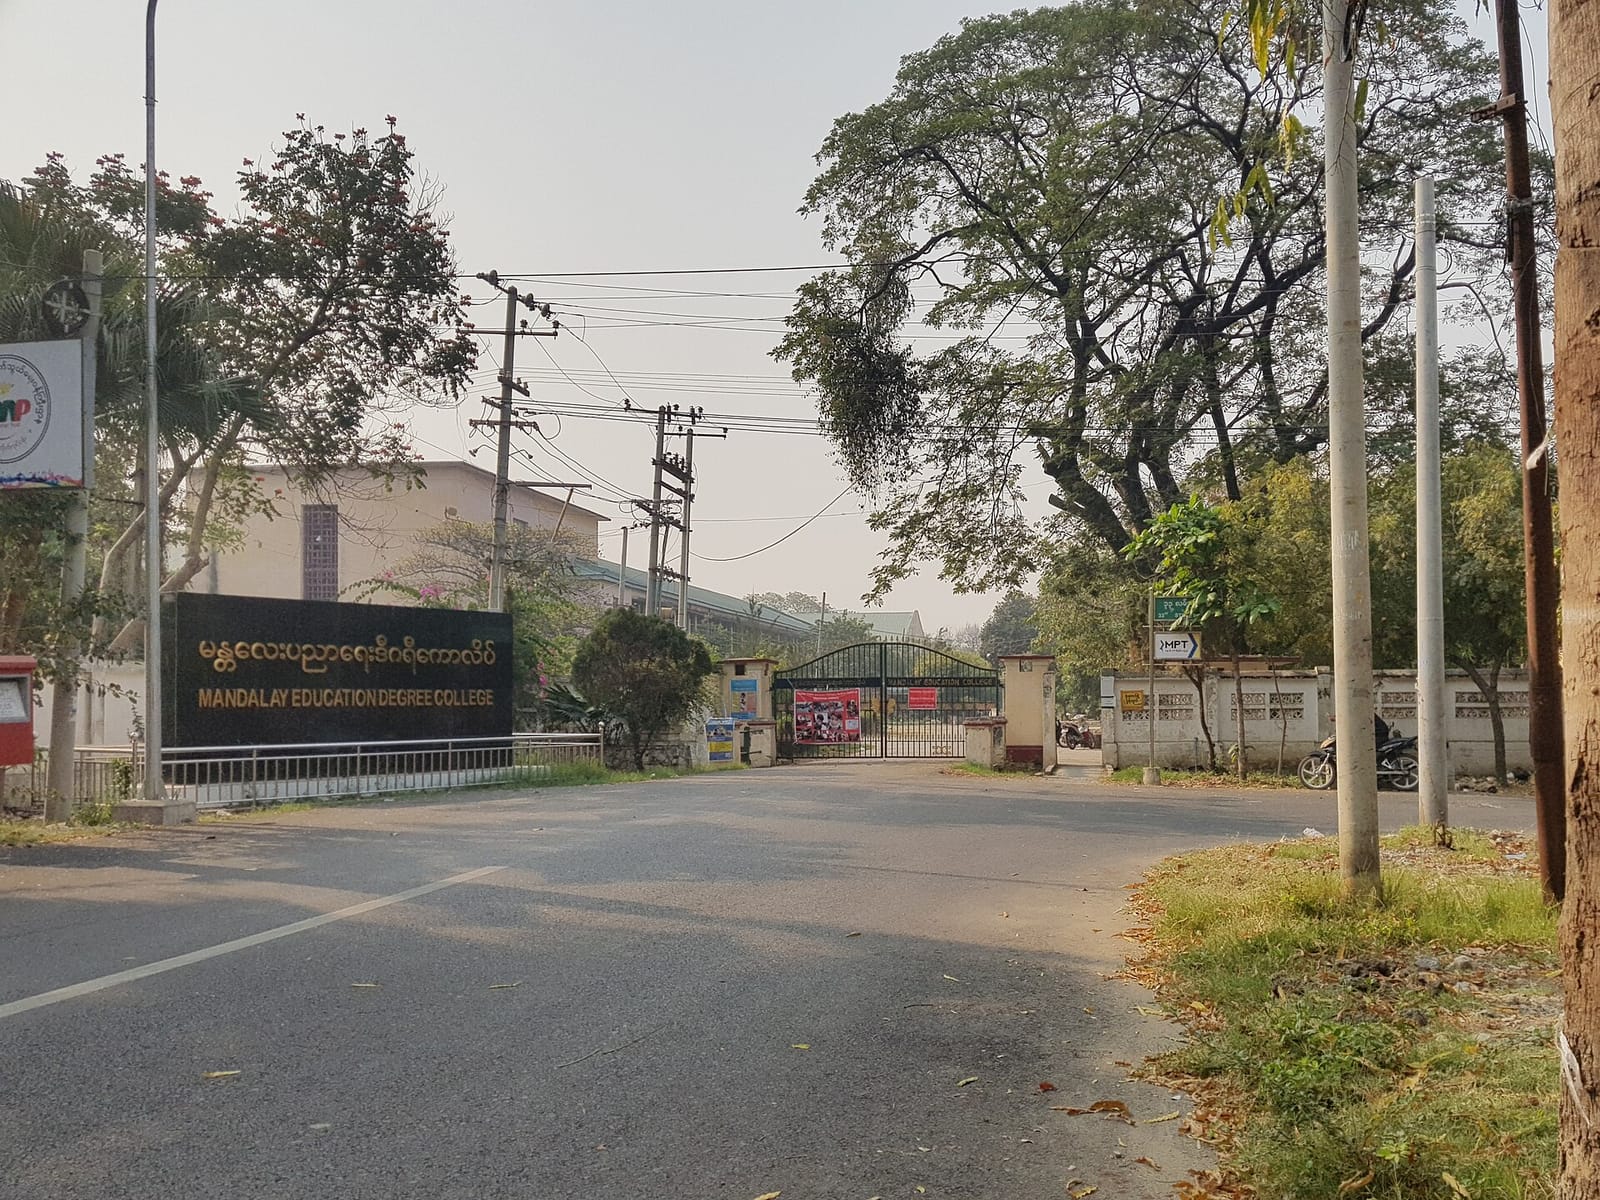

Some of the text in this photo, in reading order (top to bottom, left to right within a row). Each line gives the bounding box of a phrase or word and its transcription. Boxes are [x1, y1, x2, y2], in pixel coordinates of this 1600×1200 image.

[1165, 640, 1188, 649] MPT
[199, 687, 494, 708] MANDALAY EDUCATION DEGREE COLLEGE
